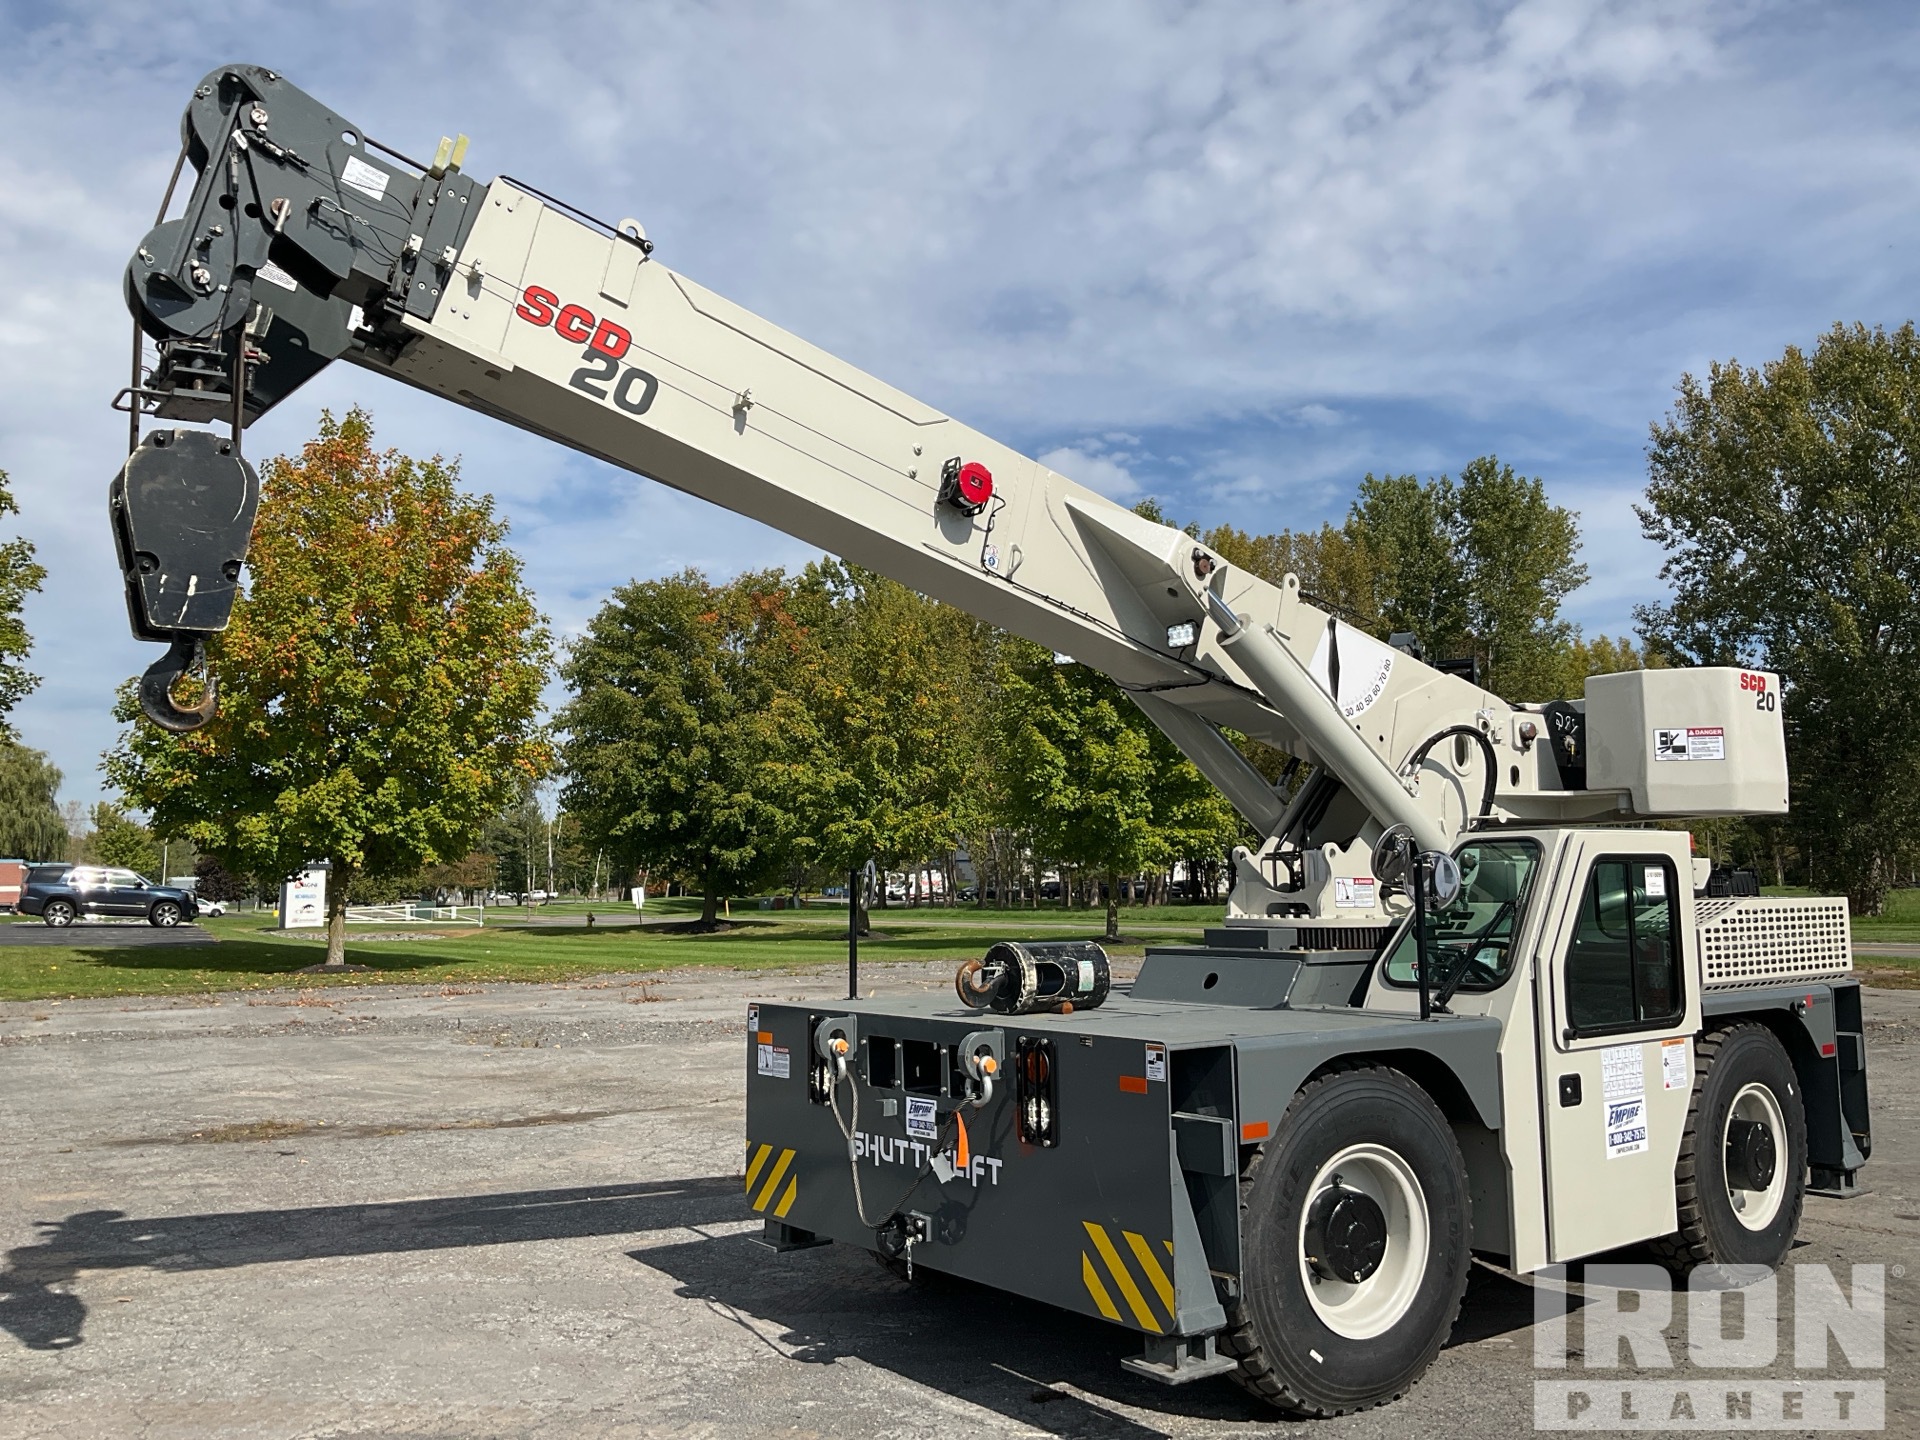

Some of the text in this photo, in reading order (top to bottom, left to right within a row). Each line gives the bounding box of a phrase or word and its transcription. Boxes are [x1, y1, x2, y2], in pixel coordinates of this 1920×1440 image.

[516, 285, 632, 360] SCD
[568, 348, 659, 416] 20
[1345, 658, 1391, 717] 30 40 50 60 70 80
[1740, 672, 1766, 692] SCD
[1756, 691, 1775, 712] 20
[908, 1103, 933, 1114] EMPIRE
[1608, 1105, 1640, 1127] EMPIRE
[1609, 1127, 1646, 1147] 1-800-342-7575
